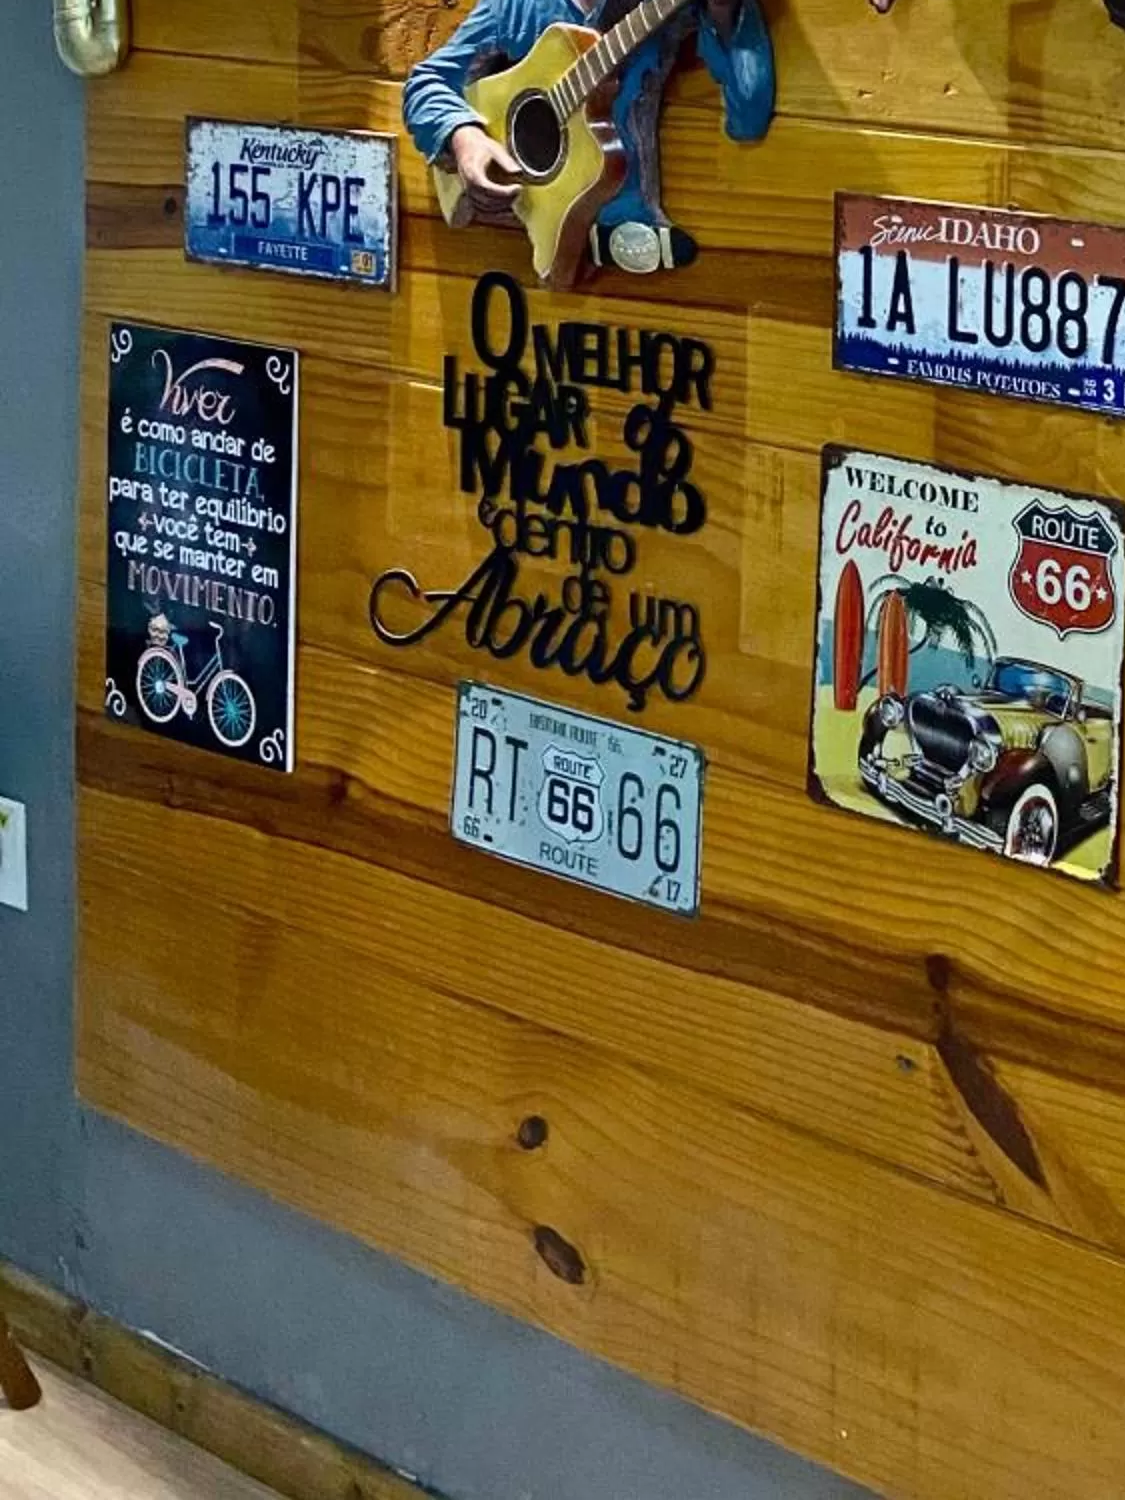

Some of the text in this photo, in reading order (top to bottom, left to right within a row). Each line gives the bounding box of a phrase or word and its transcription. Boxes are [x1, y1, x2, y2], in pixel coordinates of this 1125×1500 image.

[239, 137, 319, 171] Kentucky
[206, 161, 366, 244] 155 KPE
[257, 241, 309, 261] FAYETTE
[870, 215, 1040, 255] Scenic IDAHO
[857, 245, 916, 334] 1A
[471, 271, 715, 411] O MELHOR
[151, 349, 245, 424] Viver
[906, 359, 1061, 399] FAMOUS POTATOES
[1103, 378, 1115, 402] 3
[120, 407, 276, 463] é como andar de
[109, 476, 287, 534] para ter equilíbrio
[844, 465, 979, 514] WELCOME
[154, 513, 241, 551] você tem
[835, 499, 978, 574] California
[925, 515, 947, 537] to
[1031, 514, 1100, 550] ROUTE
[115, 530, 279, 589] que se manter em
[1035, 558, 1092, 613] 66
[471, 698, 488, 719] 20
[552, 755, 594, 780] ROUTE
[669, 754, 688, 779] 27
[468, 726, 682, 874] RT 66
[547, 778, 595, 834] 66
[463, 816, 481, 839] 66
[539, 842, 599, 877] ROUTE
[666, 879, 682, 903] 17
